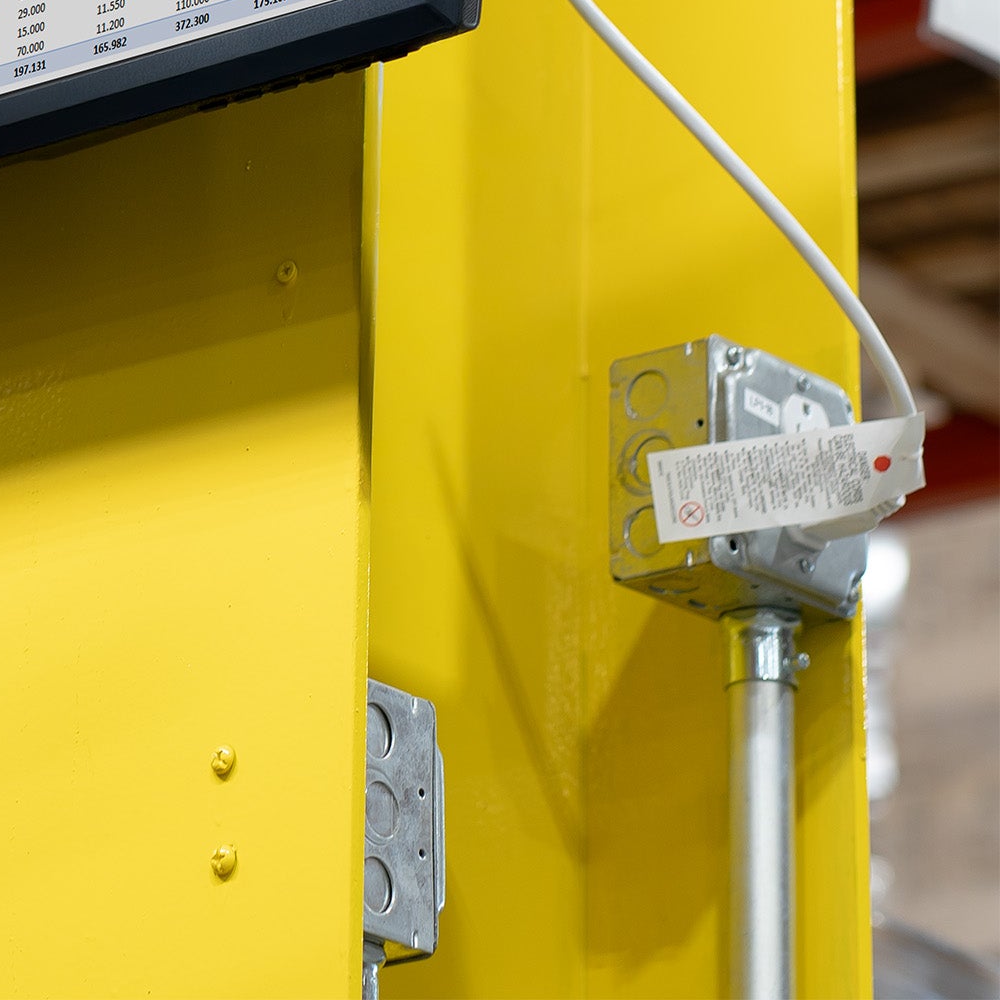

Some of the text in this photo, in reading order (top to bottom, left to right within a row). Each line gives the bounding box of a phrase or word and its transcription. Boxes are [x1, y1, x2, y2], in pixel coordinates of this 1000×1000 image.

[96, 16, 125, 35] 11.200
[174, 12, 209, 32] 372.300
[16, 39, 45, 57] 70.000
[93, 35, 127, 55] 165.982
[13, 59, 46, 78] 197.131
